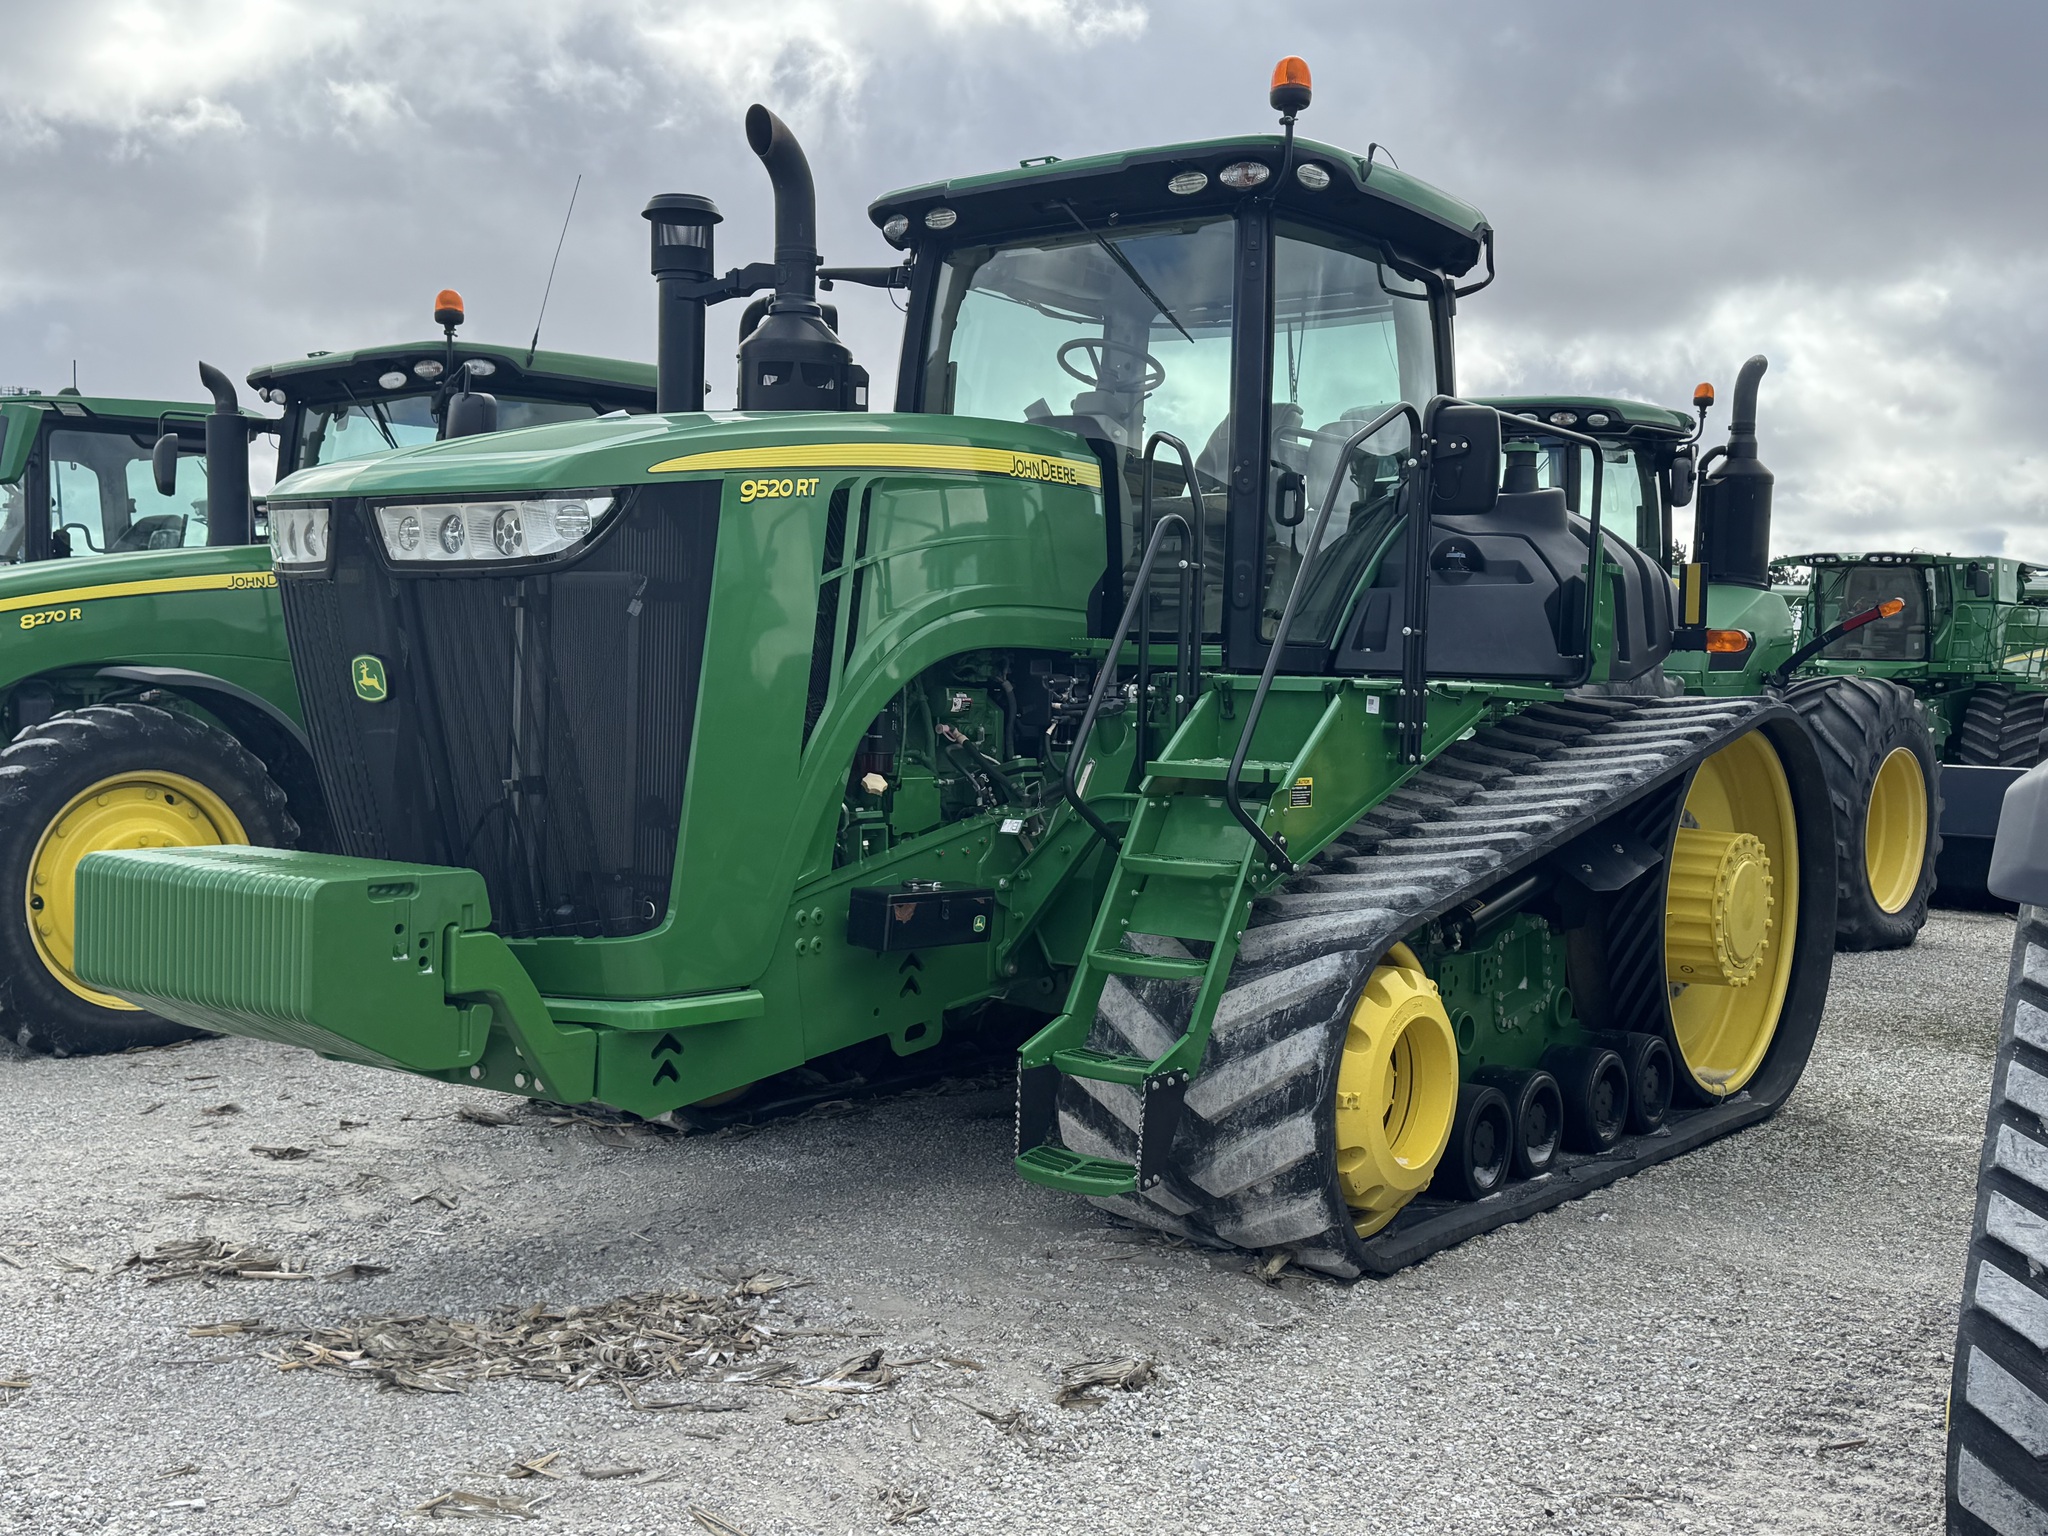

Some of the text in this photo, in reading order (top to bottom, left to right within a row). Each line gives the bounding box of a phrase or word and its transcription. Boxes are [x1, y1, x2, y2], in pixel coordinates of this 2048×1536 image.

[1009, 455, 1077, 483] JOHN DEERE
[740, 477, 820, 503] 9520 RT
[227, 575, 266, 589] JOHN
[20, 607, 82, 630] 8270 R
